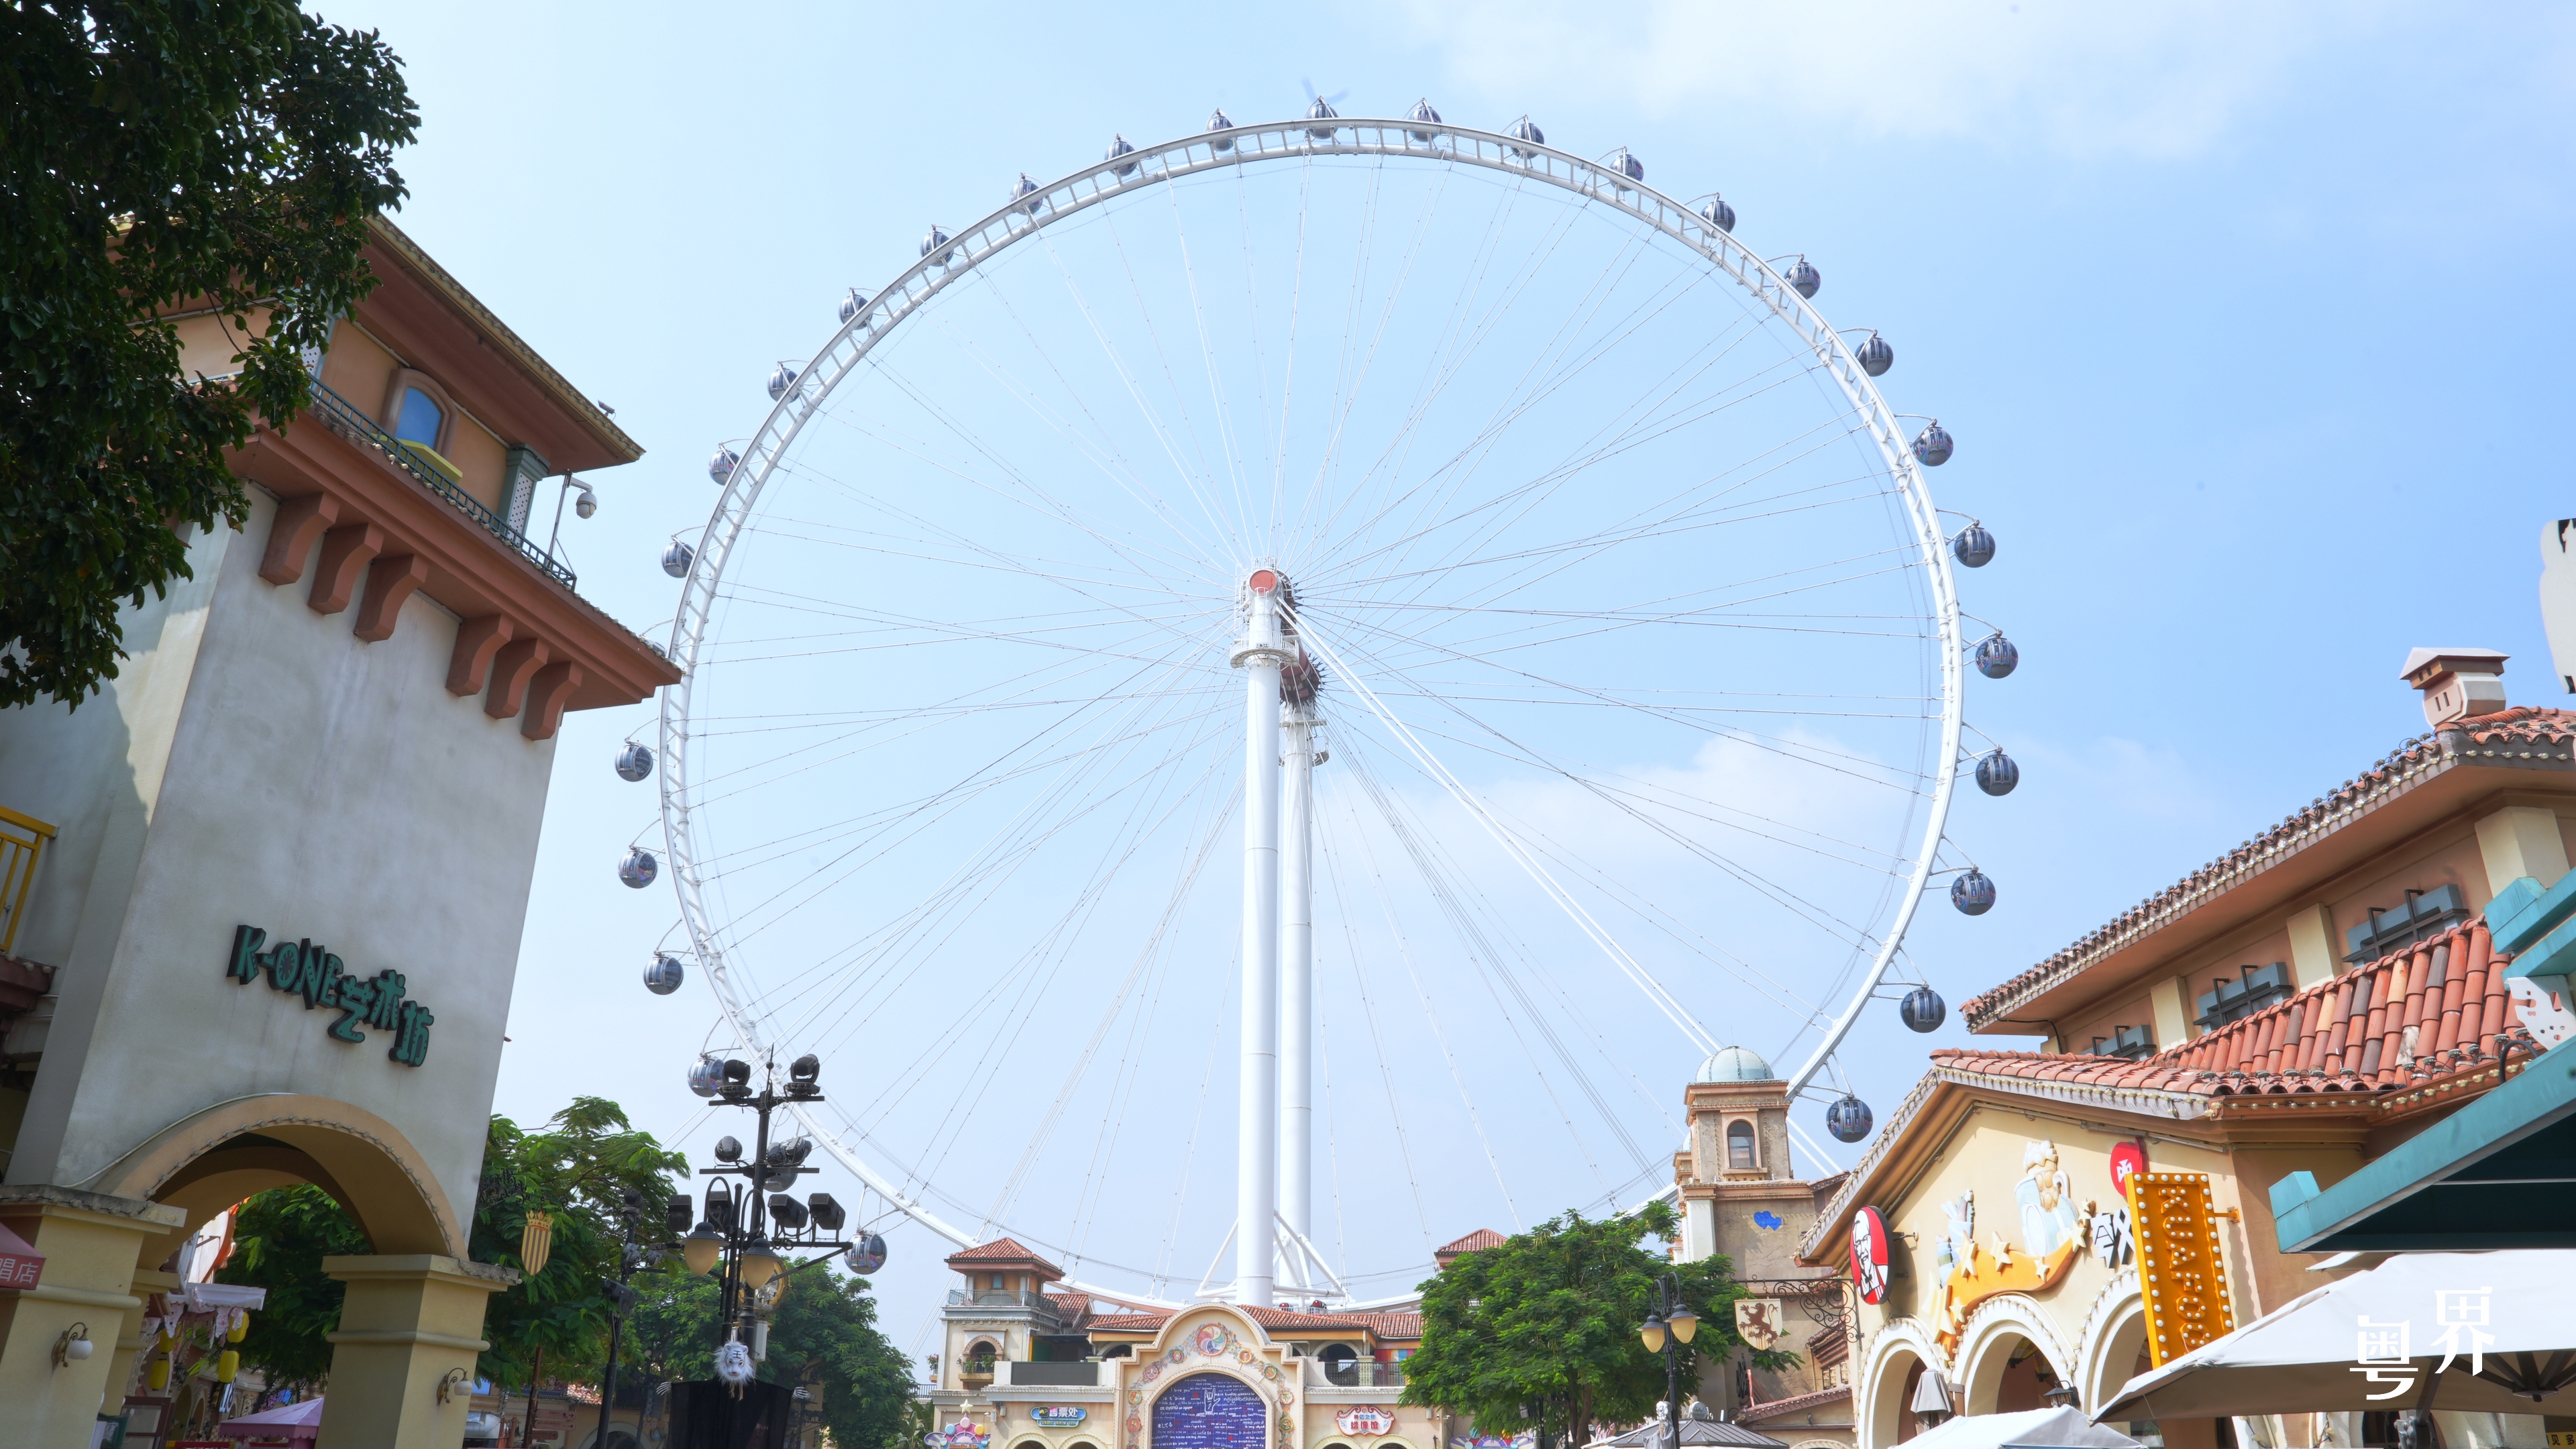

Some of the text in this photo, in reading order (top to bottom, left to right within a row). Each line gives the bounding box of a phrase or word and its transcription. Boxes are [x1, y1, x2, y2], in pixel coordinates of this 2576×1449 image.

[2158, 1186, 2212, 1350] KUAFOO
[1049, 1407, 1078, 1417] 售票处
